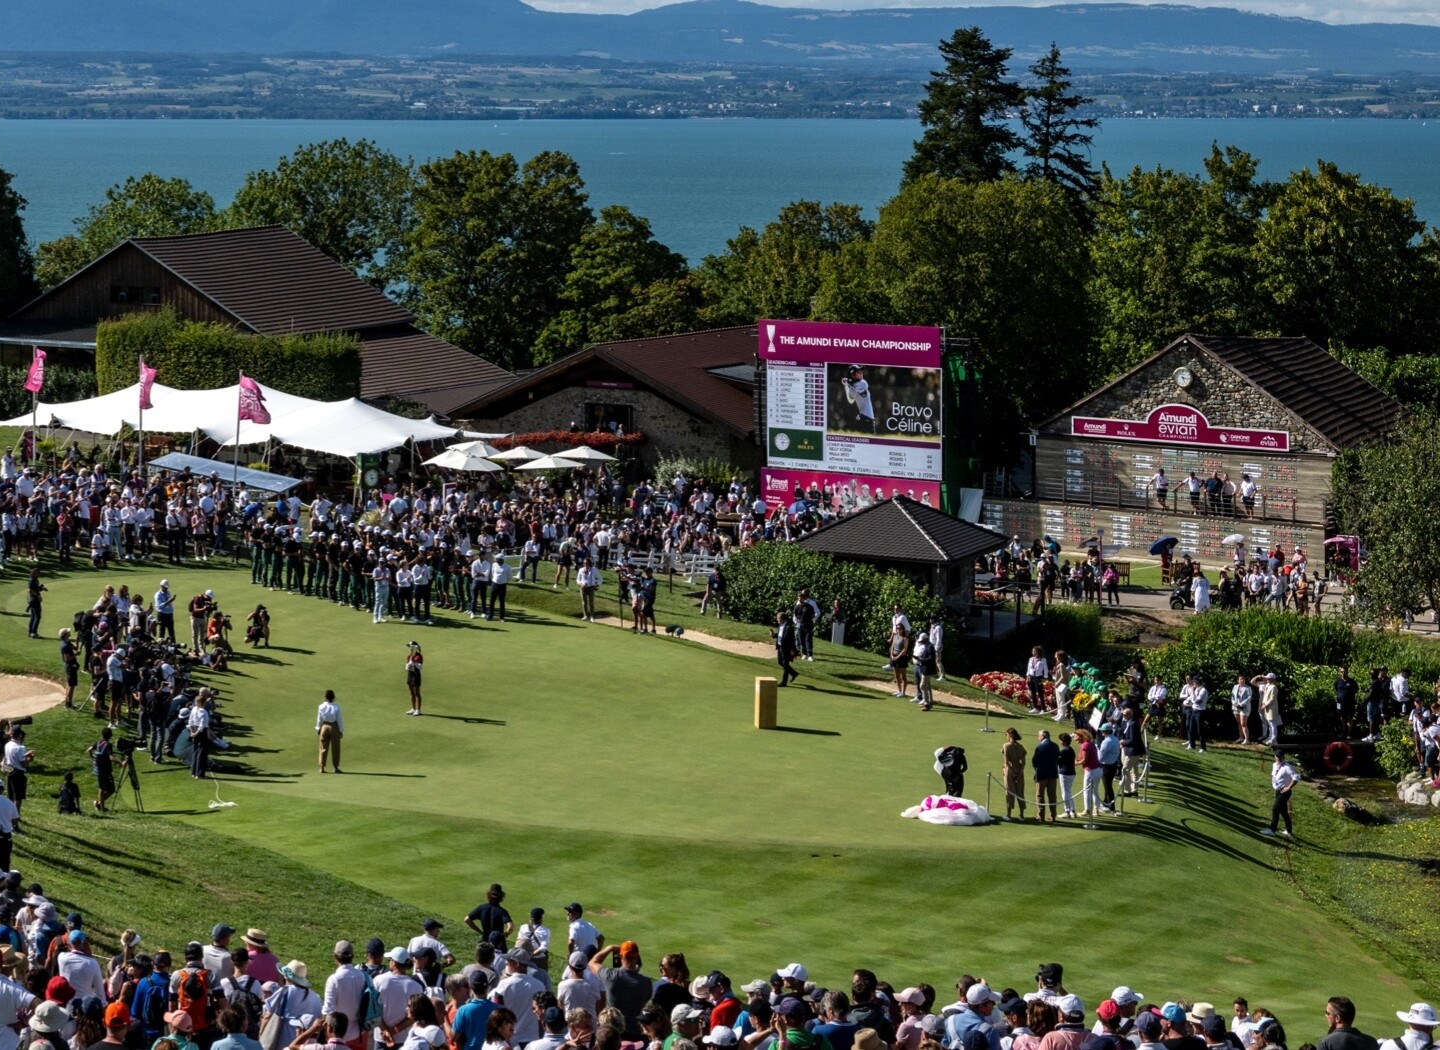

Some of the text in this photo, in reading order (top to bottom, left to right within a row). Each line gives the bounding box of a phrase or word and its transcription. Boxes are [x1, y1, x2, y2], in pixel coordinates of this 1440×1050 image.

[779, 336, 932, 352] THE AMUNDI EVIAN CHAMPIONSHIP
[892, 401, 933, 418] Bravo
[1158, 412, 1197, 424] Amundi
[886, 417, 933, 434] Céline
[1084, 422, 1107, 430] Amundi
[1158, 424, 1198, 436] evian
